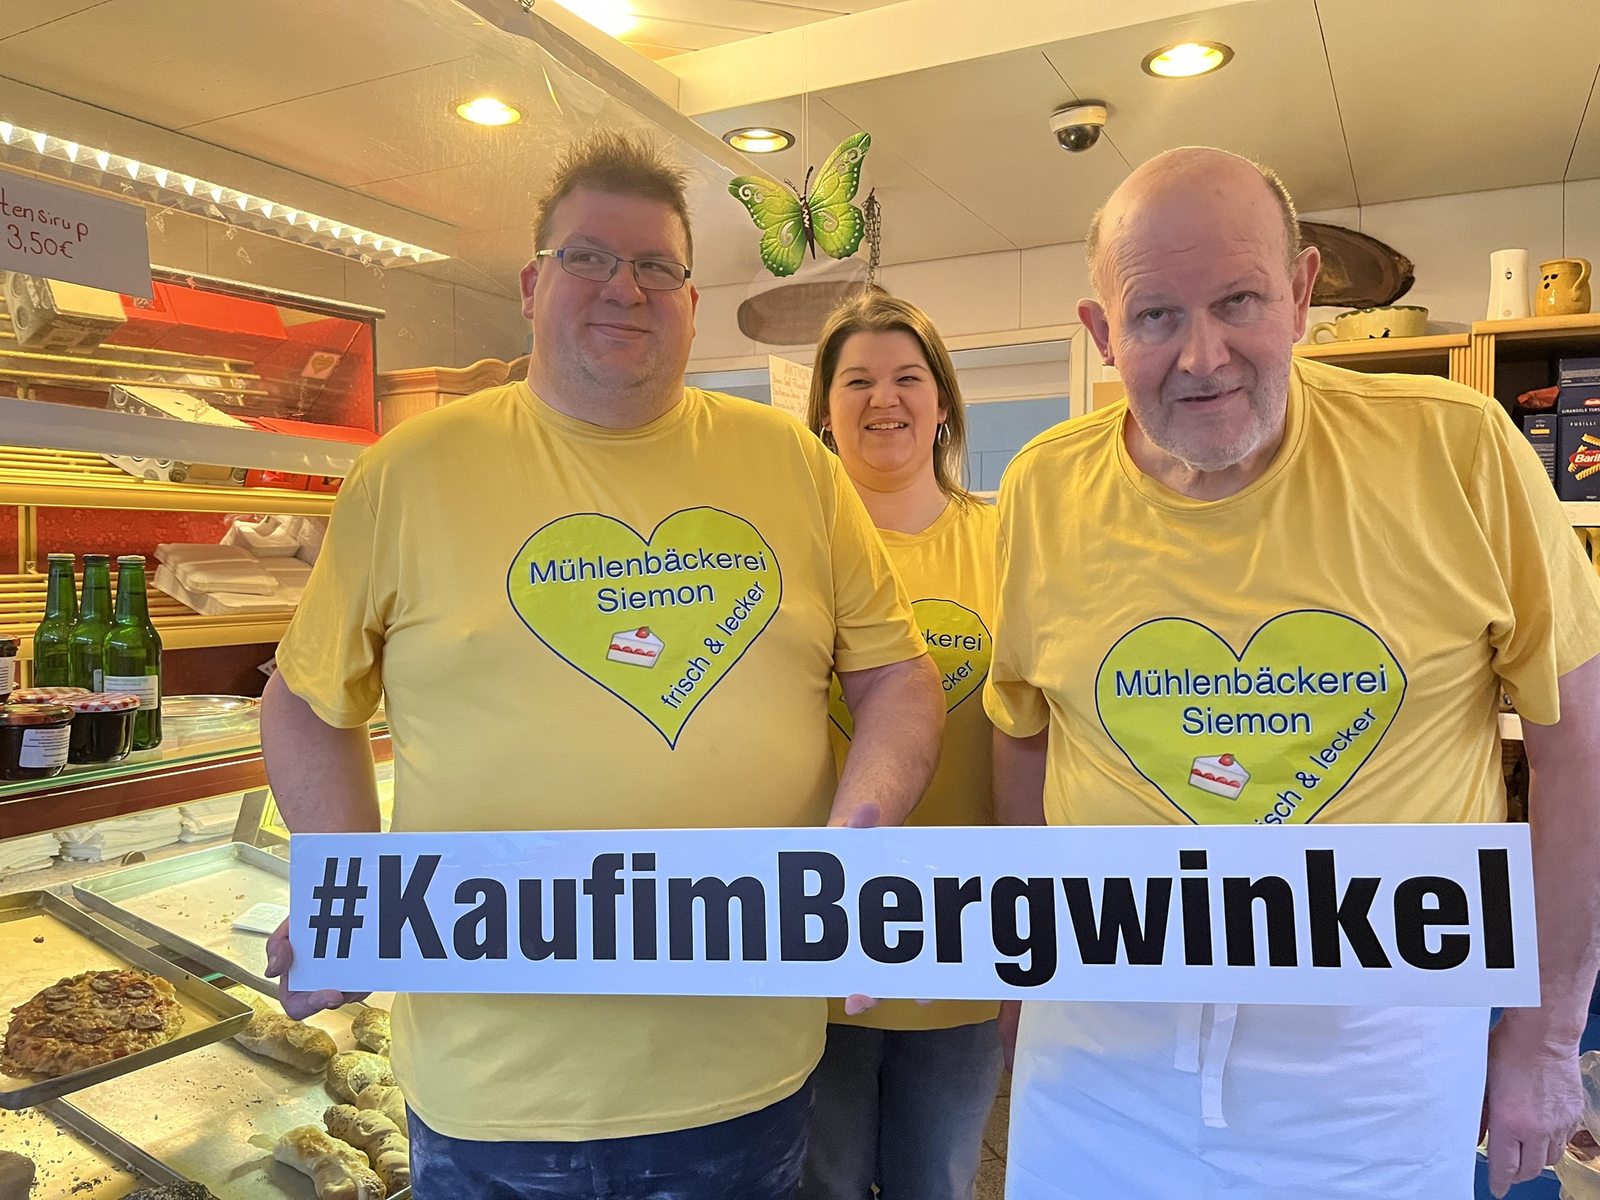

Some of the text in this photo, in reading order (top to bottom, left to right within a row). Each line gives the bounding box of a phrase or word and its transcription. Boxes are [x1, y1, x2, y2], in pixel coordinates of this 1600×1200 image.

[7, 224, 73, 258] 3,50€
[530, 548, 767, 584] Mühlenbäckerei
[597, 584, 714, 612] Siemon
[661, 581, 766, 708] frisch & lecker
[921, 629, 982, 651] kerei
[1116, 664, 1388, 697] Mühlenbäckerei
[1183, 707, 1311, 734] Siemon
[1296, 772, 1320, 788] &
[1310, 707, 1377, 770] lecker
[309, 848, 1515, 987] #KaufimBergwinkel
